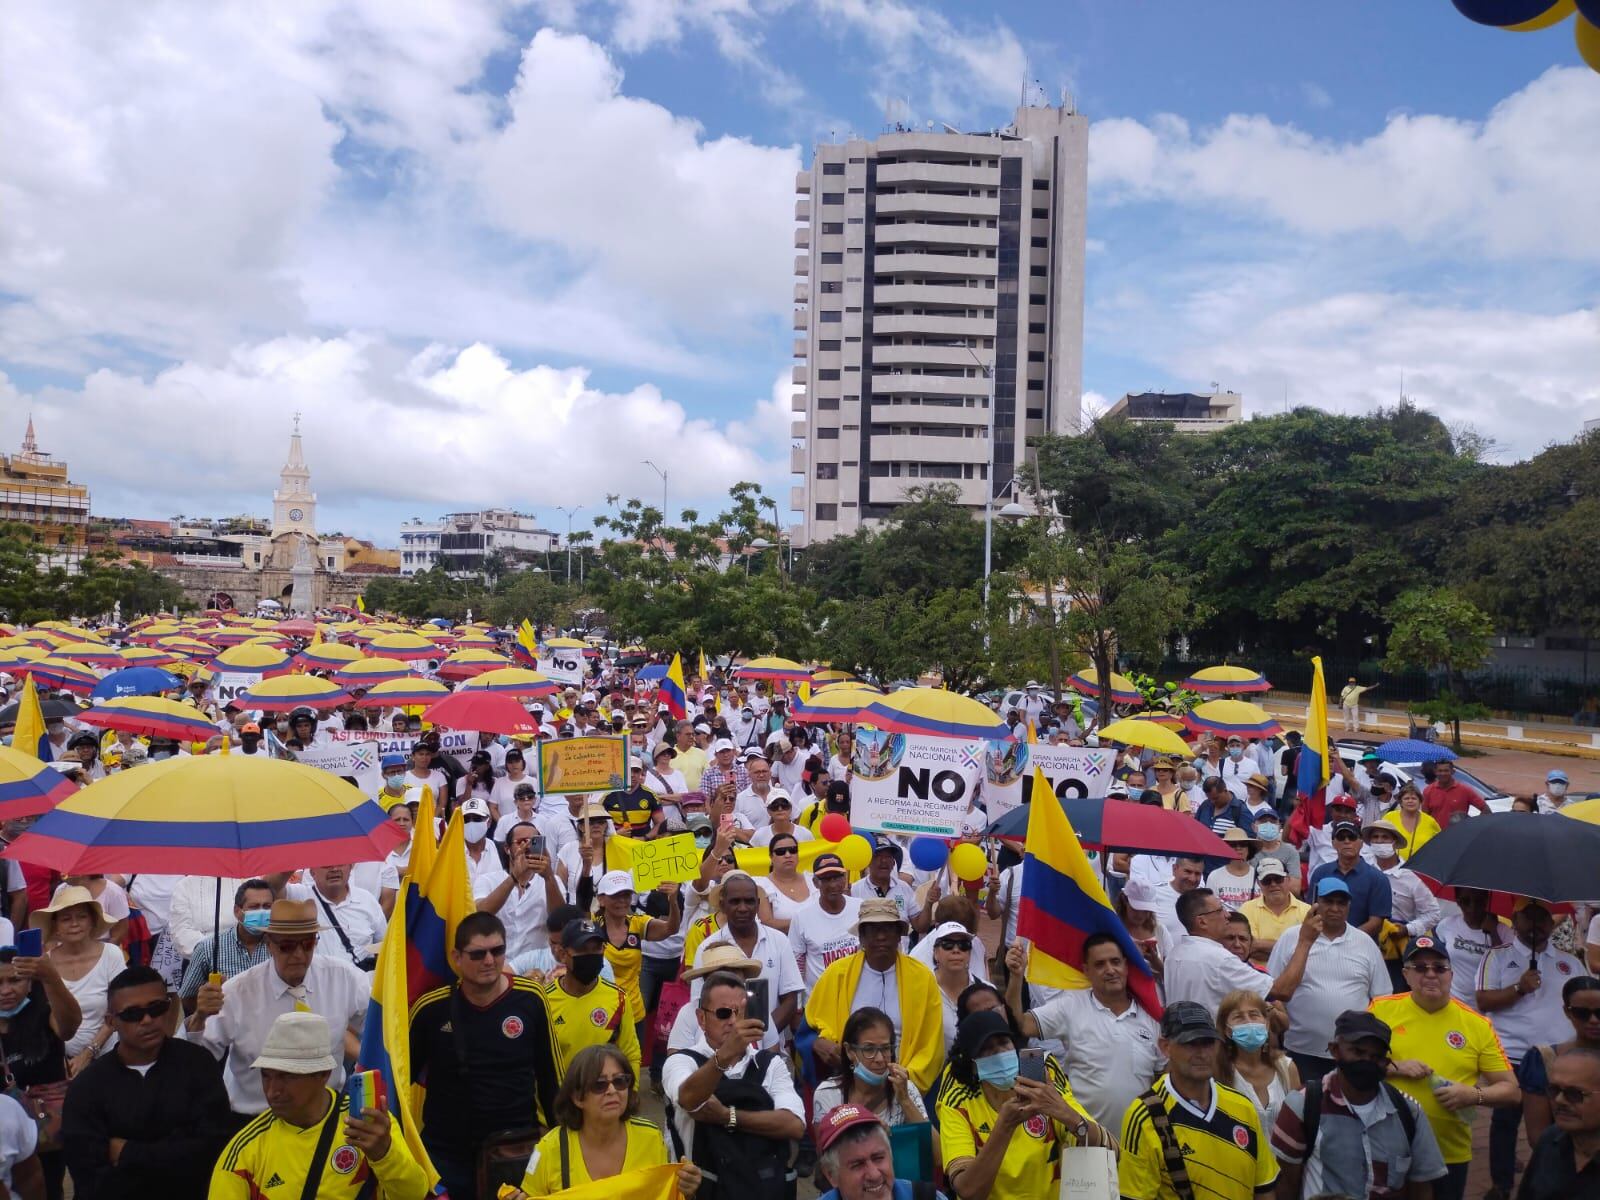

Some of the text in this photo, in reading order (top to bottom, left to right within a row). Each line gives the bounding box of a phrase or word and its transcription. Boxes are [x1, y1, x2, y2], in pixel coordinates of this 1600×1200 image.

[552, 657, 578, 671] NO
[909, 744, 958, 755] GRAN MARCHA
[909, 751, 957, 763] NACIONAL
[1054, 755, 1081, 763] MARCHA
[1032, 761, 1081, 771] NACIONAL
[897, 766, 966, 803] NO
[874, 798, 911, 807] REFORMA
[896, 807, 940, 818] PENSIONES
[632, 844, 657, 862] NO
[636, 852, 699, 882] PETRO
